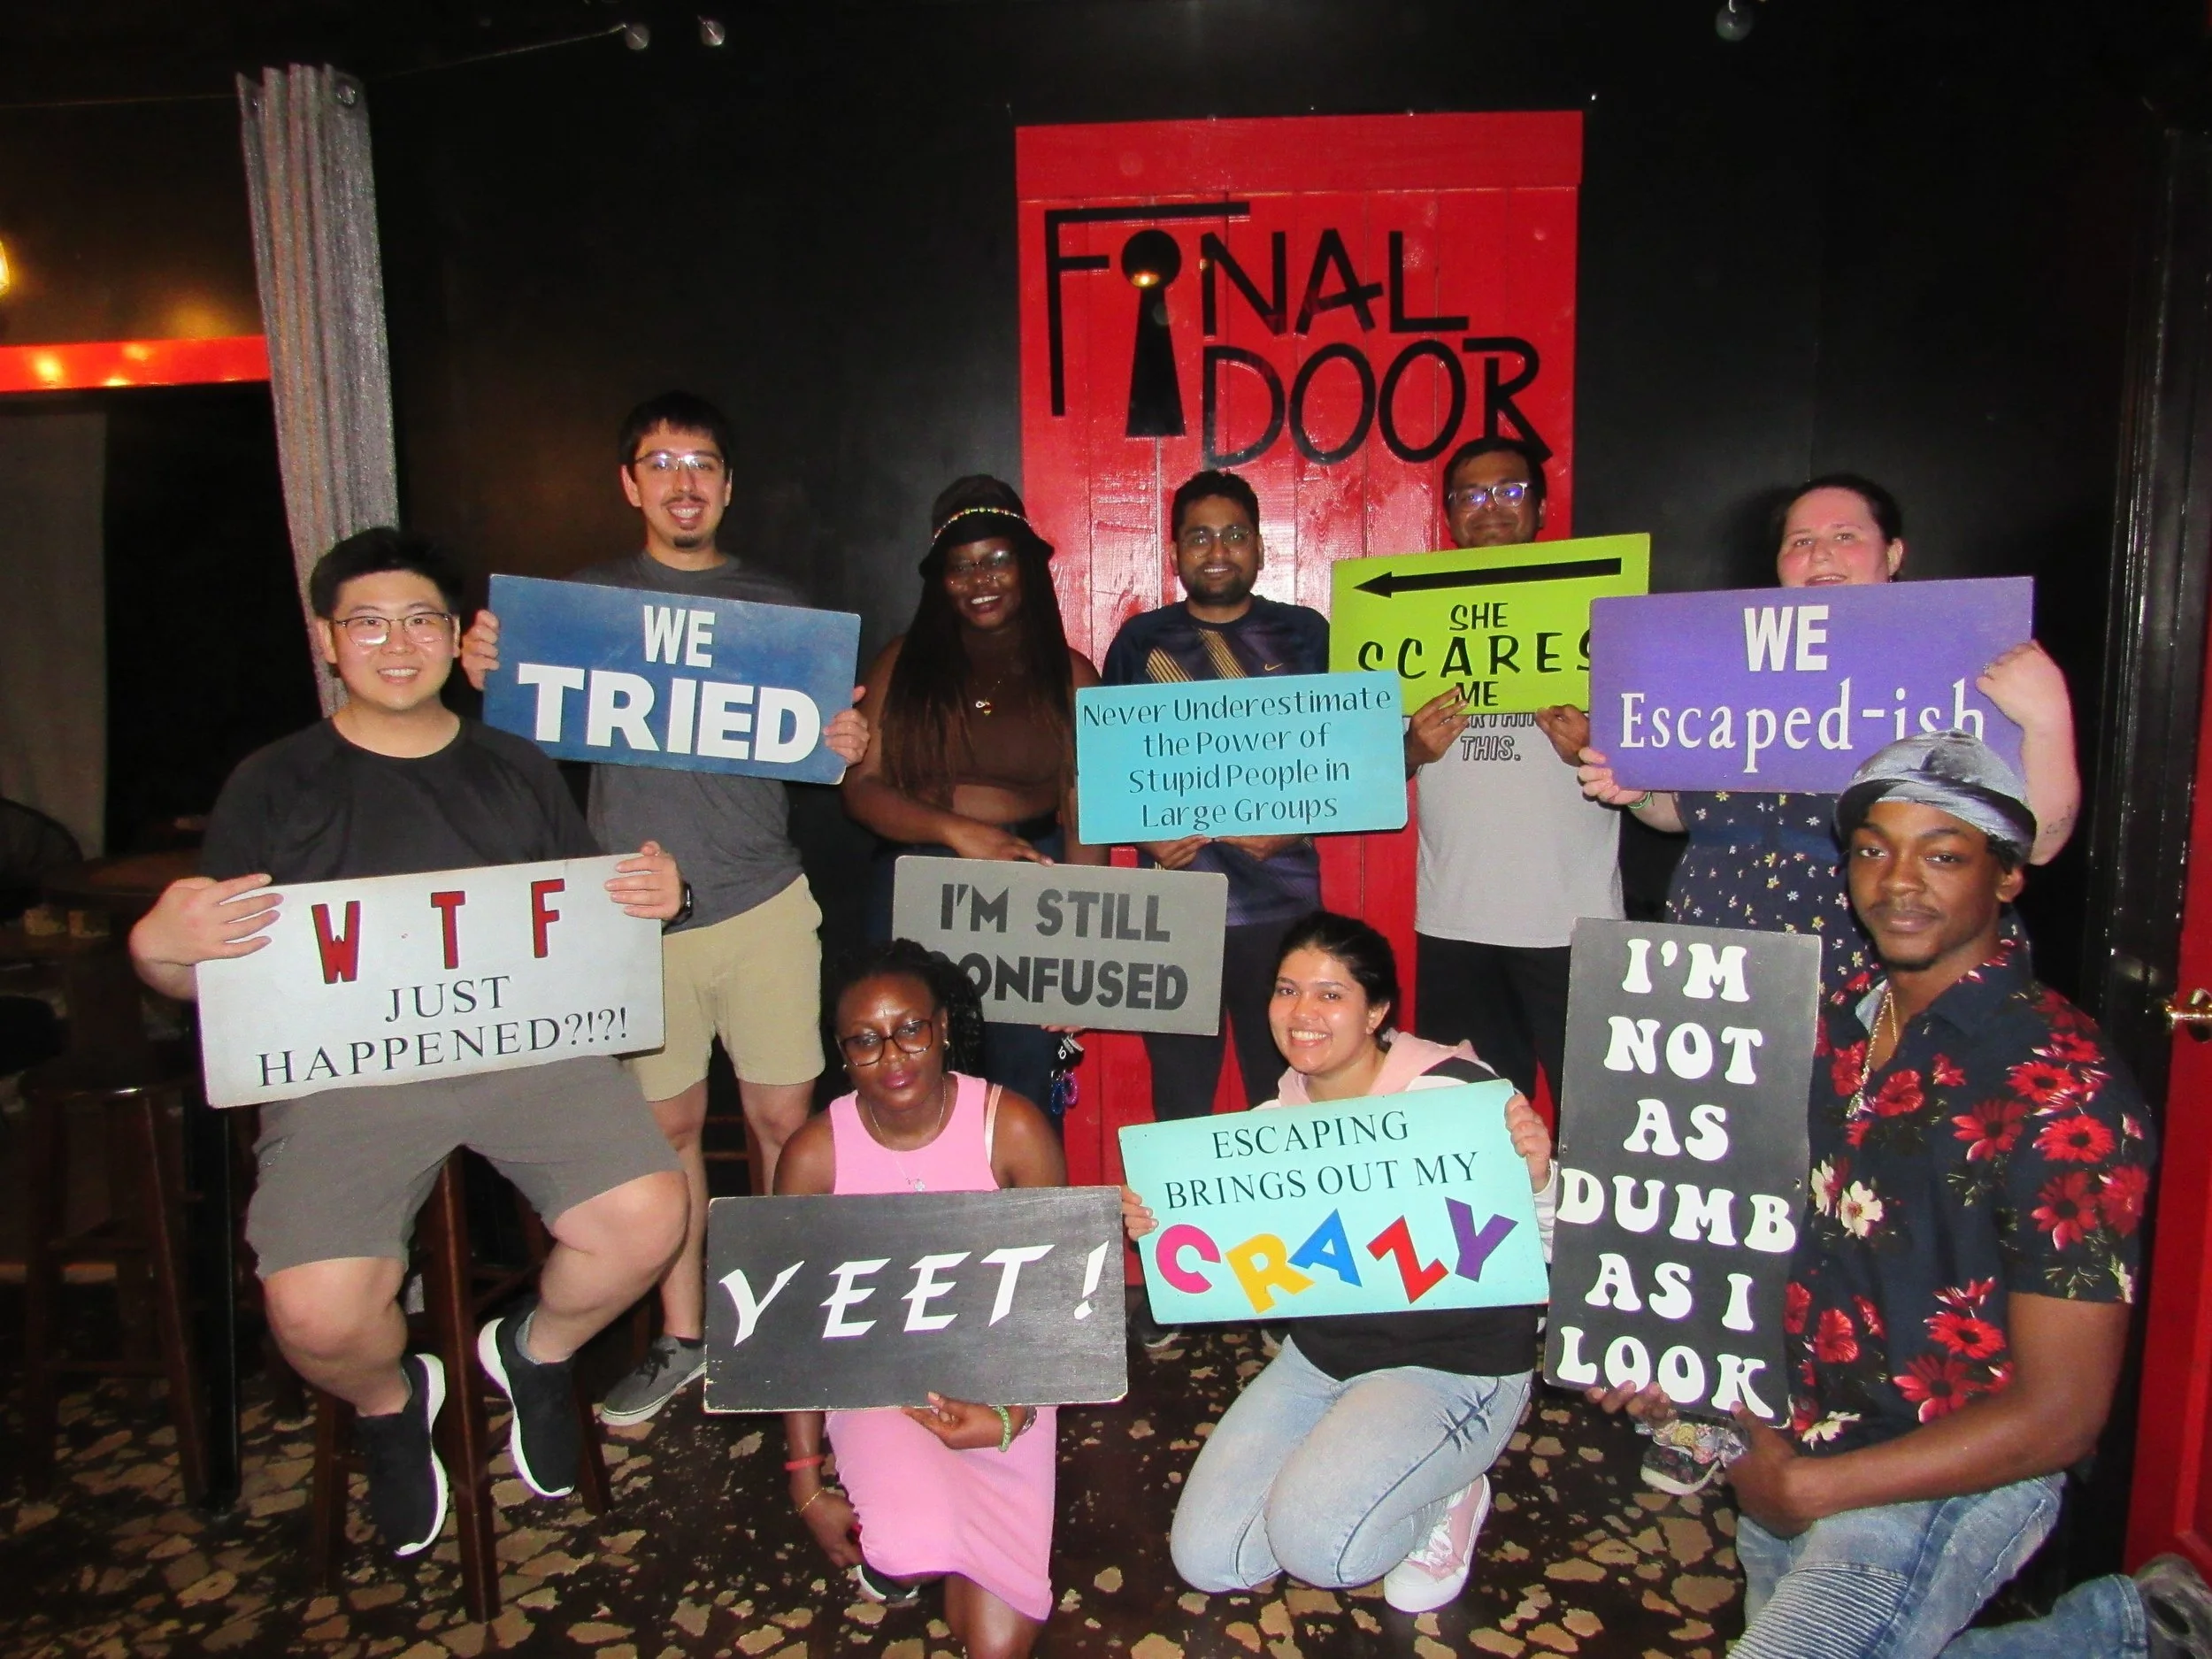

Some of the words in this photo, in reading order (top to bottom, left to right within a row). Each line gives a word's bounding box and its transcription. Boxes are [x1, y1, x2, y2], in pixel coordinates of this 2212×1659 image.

[1044, 202, 1469, 437] FINAL
[1202, 336, 1552, 467] DOOR
[644, 605, 715, 668] WE
[1448, 603, 1509, 631] SHE
[1744, 605, 1829, 672] WE
[518, 663, 821, 764] TRIED
[1083, 703, 1166, 727] Never
[1174, 686, 1392, 721] Underestimate
[1455, 680, 1499, 707] ME
[1143, 733, 1189, 758] the
[1197, 729, 1292, 755] Power
[1300, 722, 1332, 748] of
[1461, 735, 1521, 761] THIS.
[1129, 764, 1220, 796] Stupid
[1227, 758, 1318, 791] People
[1325, 758, 1350, 782] in
[1142, 802, 1226, 832] Large
[1234, 797, 1338, 825] Groups
[941, 883, 1009, 933] I'M
[1036, 888, 1171, 942] STILL
[386, 975, 511, 1023] JUST
[929, 950, 1188, 1010] ONFUSED
[1622, 938, 1750, 1002] I'M
[257, 1006, 628, 1087] HAPPENED?!?!
[1603, 1016, 1763, 1085] NOT
[1212, 1110, 1409, 1159] ESCAPING
[1623, 1098, 1729, 1161] AS
[1164, 1169, 1306, 1209] BRINGS
[1317, 1160, 1398, 1194] OUT
[1415, 1151, 1479, 1187] MY
[1556, 1167, 1796, 1253] DUMB
[1156, 1196, 1518, 1314] CRAZY
[718, 1240, 1110, 1347] YEET!
[1585, 1253, 1692, 1320] AS
[1722, 1273, 1755, 1331] I
[1556, 1326, 1774, 1418] LOOK
